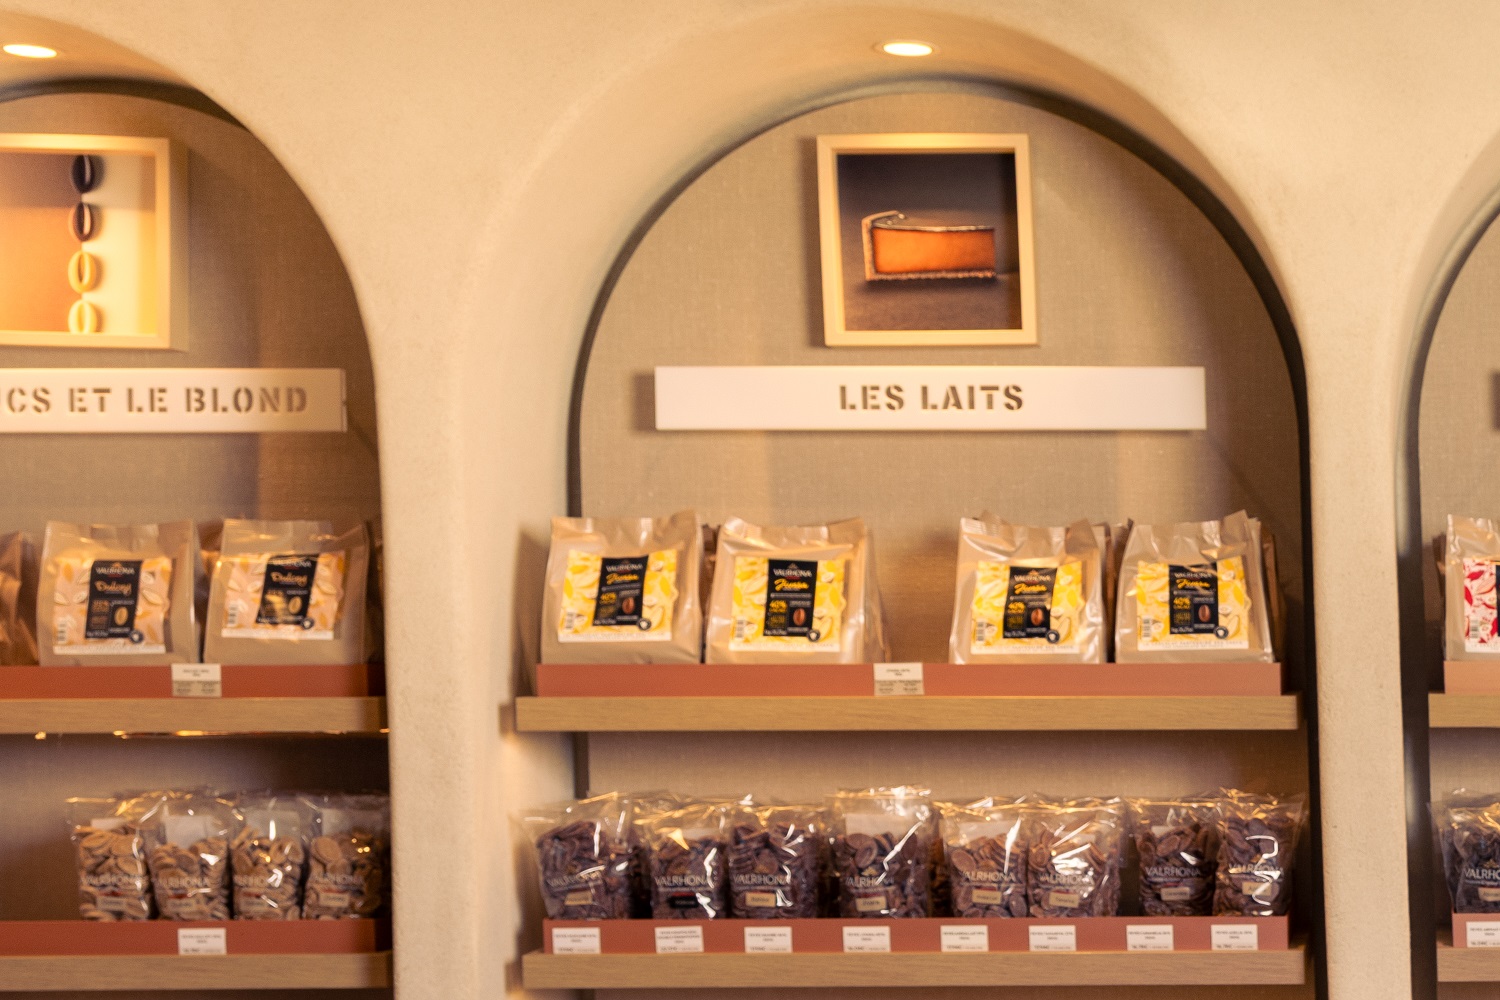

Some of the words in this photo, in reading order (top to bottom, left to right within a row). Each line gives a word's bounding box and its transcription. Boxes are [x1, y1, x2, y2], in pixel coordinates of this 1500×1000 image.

[0, 386, 51, 413] CS
[69, 386, 111, 412] ET
[127, 387, 168, 412] LE
[185, 386, 308, 413] BLOND
[839, 384, 904, 411] LES
[921, 384, 1023, 411] LAITS
